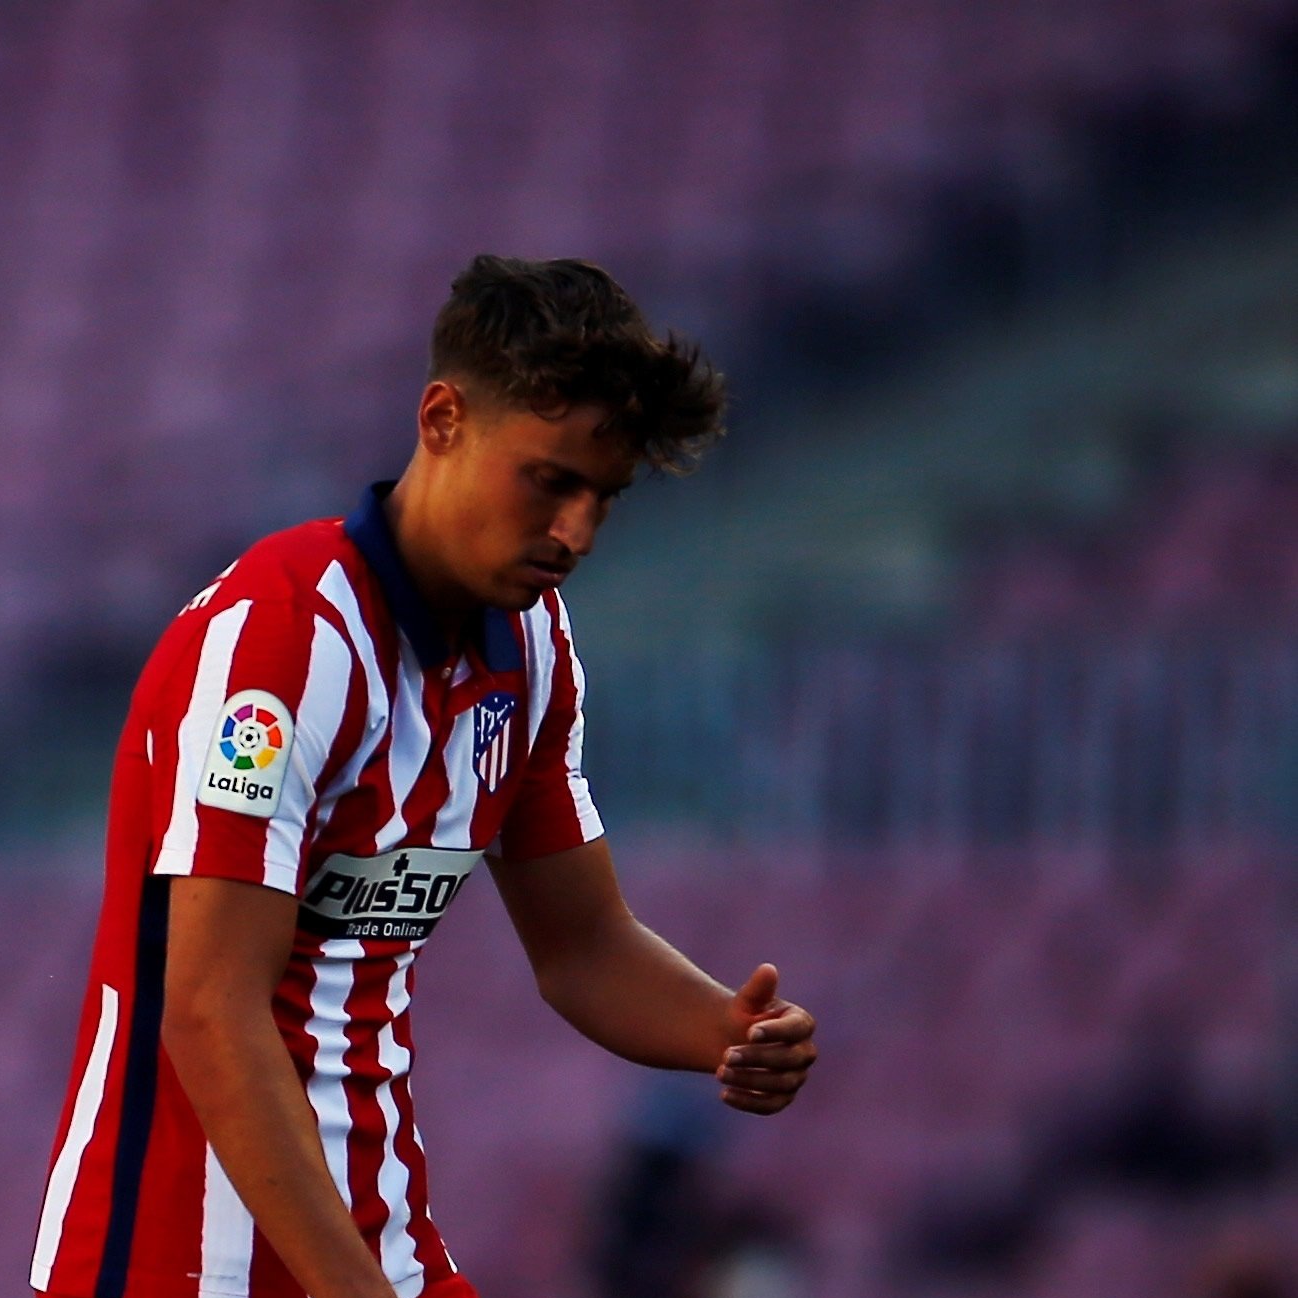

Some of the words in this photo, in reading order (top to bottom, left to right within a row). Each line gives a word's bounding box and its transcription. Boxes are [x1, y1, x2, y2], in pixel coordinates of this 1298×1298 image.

[208, 772, 274, 801] LaLiga
[305, 870, 471, 915] Plus50
[383, 921, 424, 938] Online
